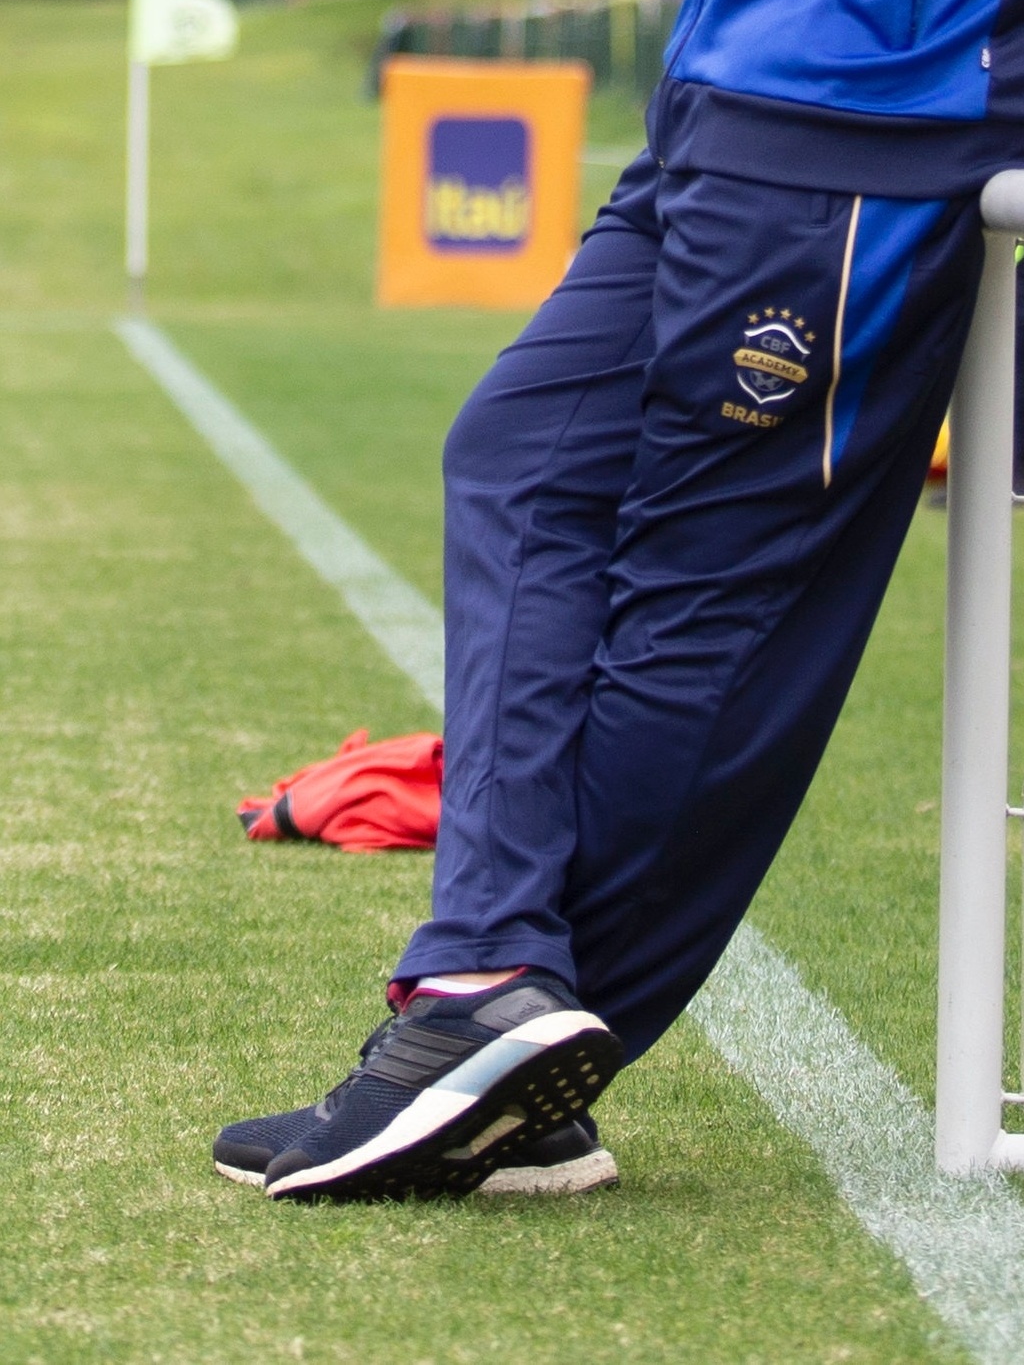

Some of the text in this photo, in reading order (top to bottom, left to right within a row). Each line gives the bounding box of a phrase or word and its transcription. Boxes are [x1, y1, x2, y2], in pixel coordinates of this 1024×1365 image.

[760, 336, 791, 354] CBF
[741, 353, 800, 377] ACADEMY
[721, 402, 785, 427] BRASI
